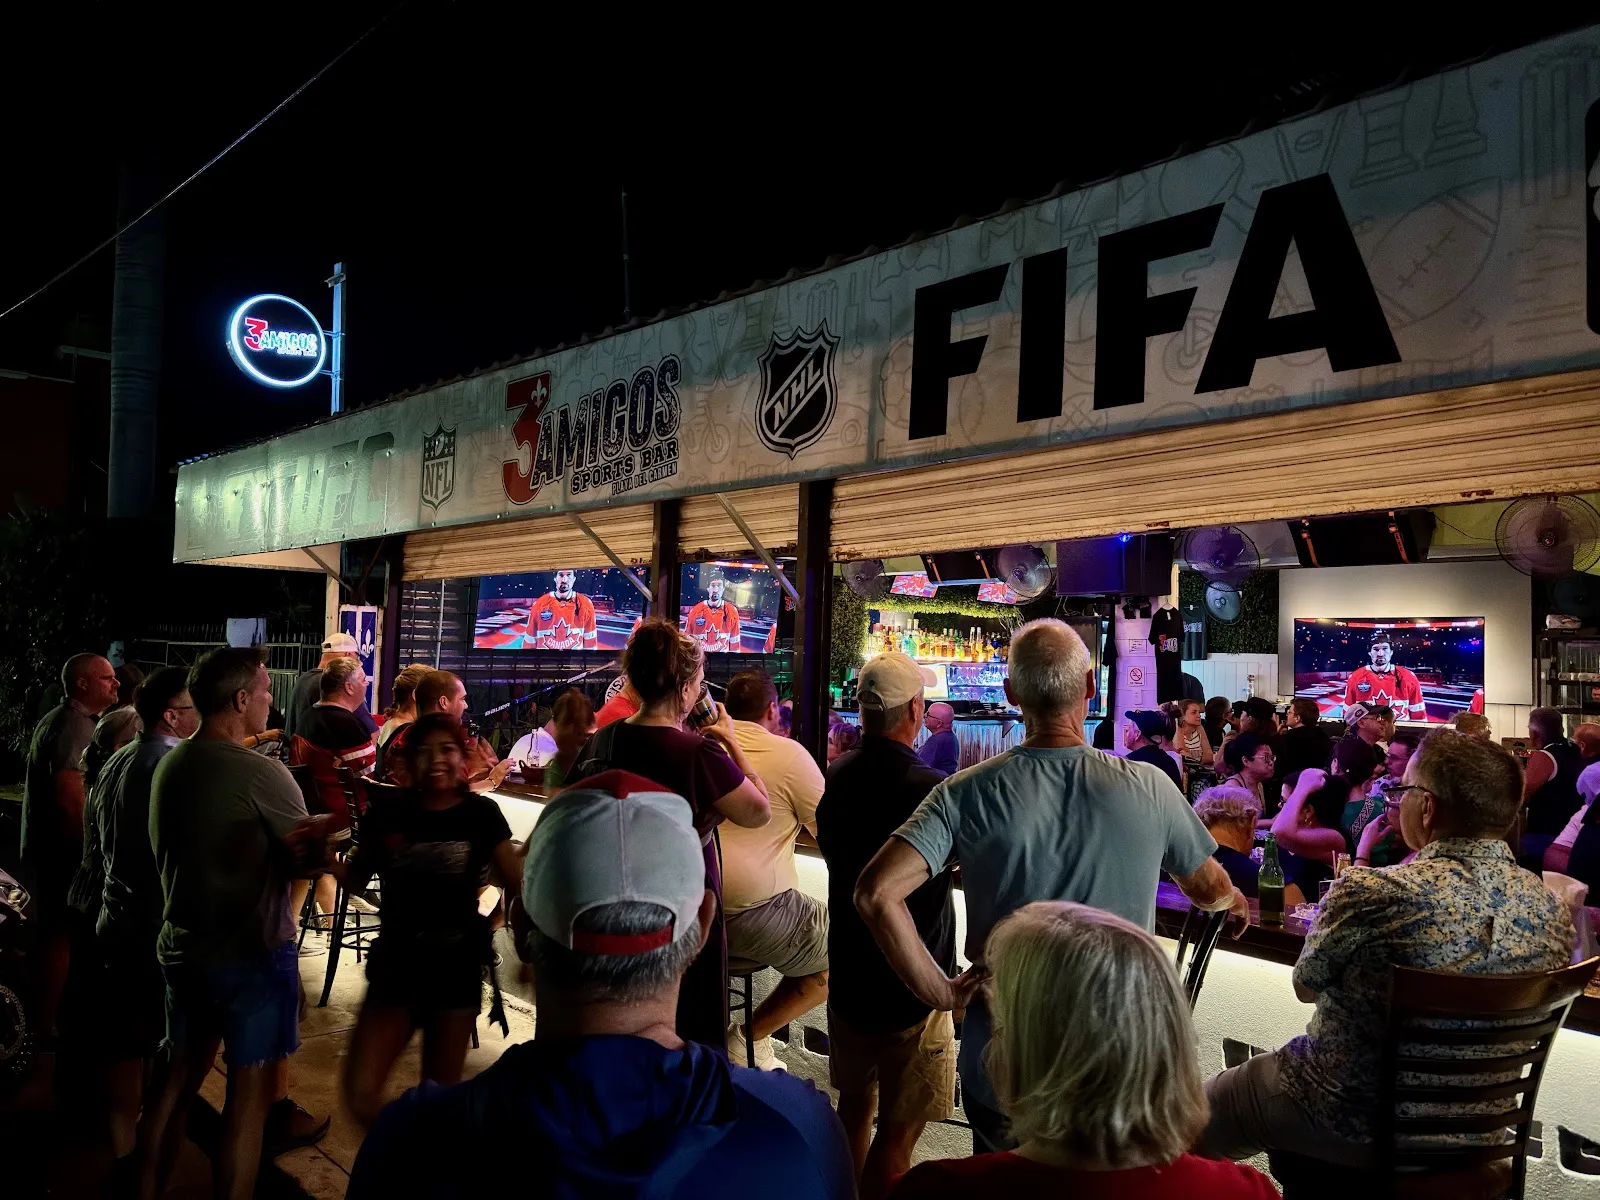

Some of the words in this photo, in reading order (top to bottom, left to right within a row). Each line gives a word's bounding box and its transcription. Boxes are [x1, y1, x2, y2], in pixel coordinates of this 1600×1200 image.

[909, 173, 1402, 440] FIFA
[245, 317, 268, 351] 3
[259, 330, 318, 351] AMIGOS
[773, 358, 821, 431] NHL
[502, 370, 551, 505] 3
[530, 353, 682, 490] AMIGOS
[424, 460, 452, 501] NFL
[571, 454, 635, 495] SPORTS
[640, 437, 680, 473] BAR
[612, 477, 634, 495] PLAYA
[634, 471, 648, 489] DEL
[648, 461, 678, 484] CARMEN
[547, 636, 576, 650] CANADA
